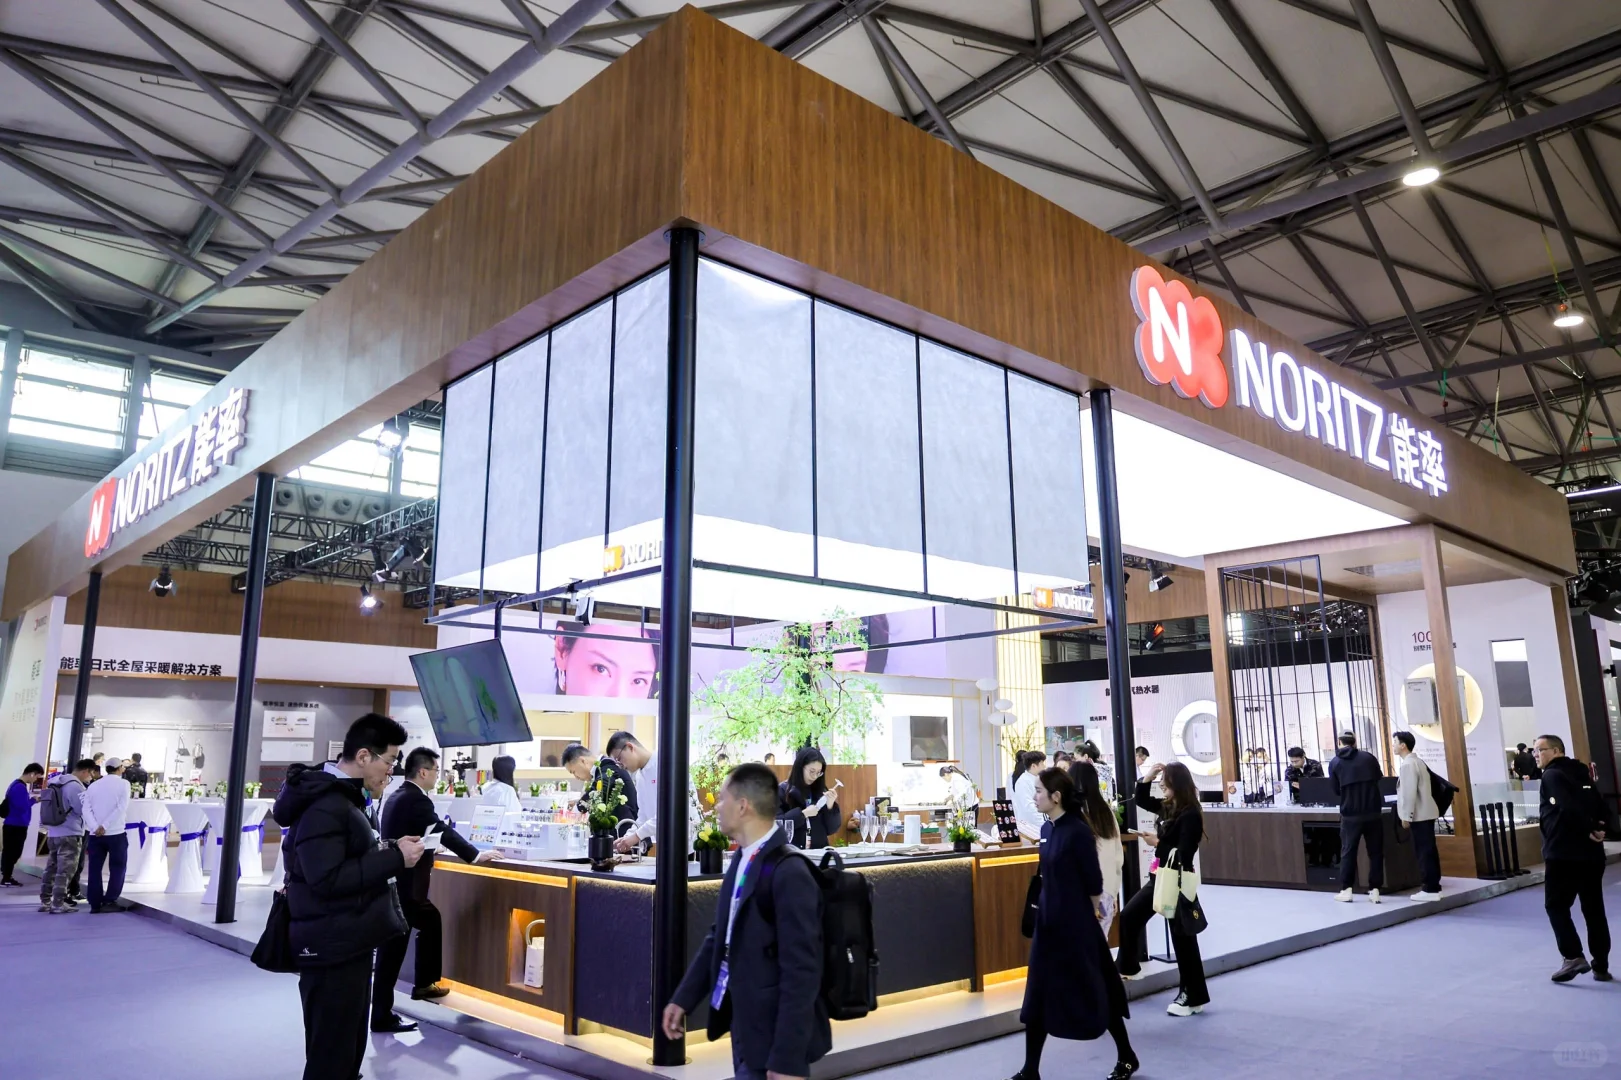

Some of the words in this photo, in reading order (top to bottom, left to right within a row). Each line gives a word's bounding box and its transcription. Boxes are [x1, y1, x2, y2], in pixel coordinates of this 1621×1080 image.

[111, 424, 197, 533] NORITZ
[191, 387, 247, 485] 能率
[1230, 329, 1389, 471] NORITZ
[1386, 412, 1448, 497] 能率
[1053, 591, 1094, 613] NORITZ
